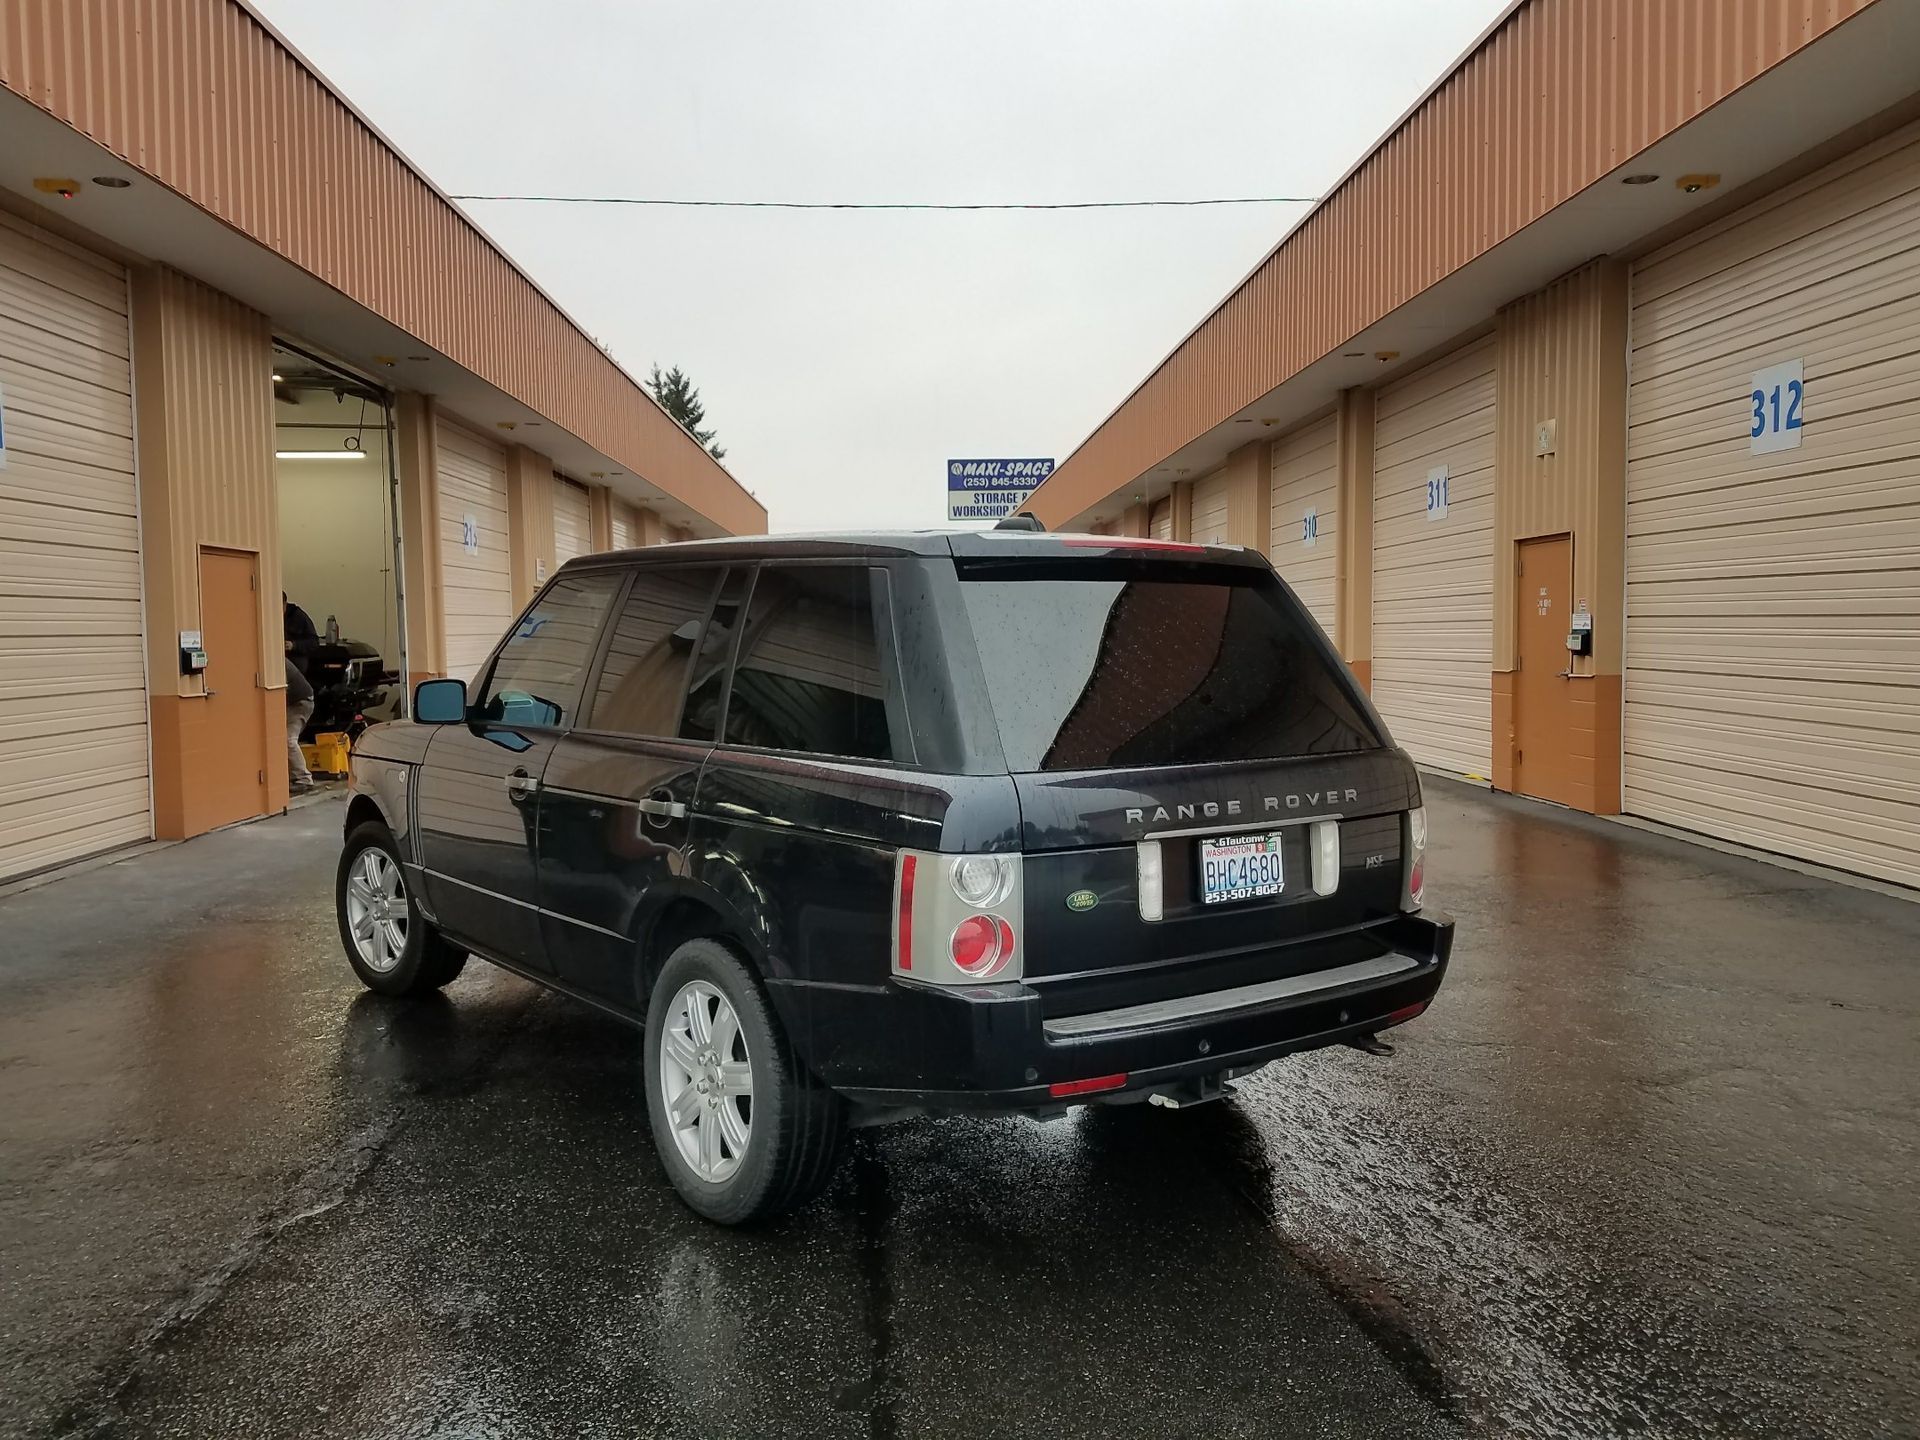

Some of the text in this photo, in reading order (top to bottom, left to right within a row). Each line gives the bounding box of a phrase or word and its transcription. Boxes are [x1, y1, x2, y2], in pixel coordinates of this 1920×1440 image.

[1751, 379, 1802, 438] 312
[963, 462, 1051, 477] MAXI-SPACE
[963, 477, 989, 488] (253)
[973, 492, 1018, 504] STORAGE
[1428, 476, 1447, 511] 311
[952, 505, 1010, 517] WORKSHOP
[1303, 514, 1317, 541] 310
[1125, 788, 1359, 824] RANGE ROVER
[1205, 845, 1252, 858] WASHINGTON
[1206, 852, 1280, 892] BHC4680
[1074, 894, 1090, 902] LAND
[1205, 882, 1285, 904] 253-507-8027
[1075, 899, 1094, 908] ROVER
